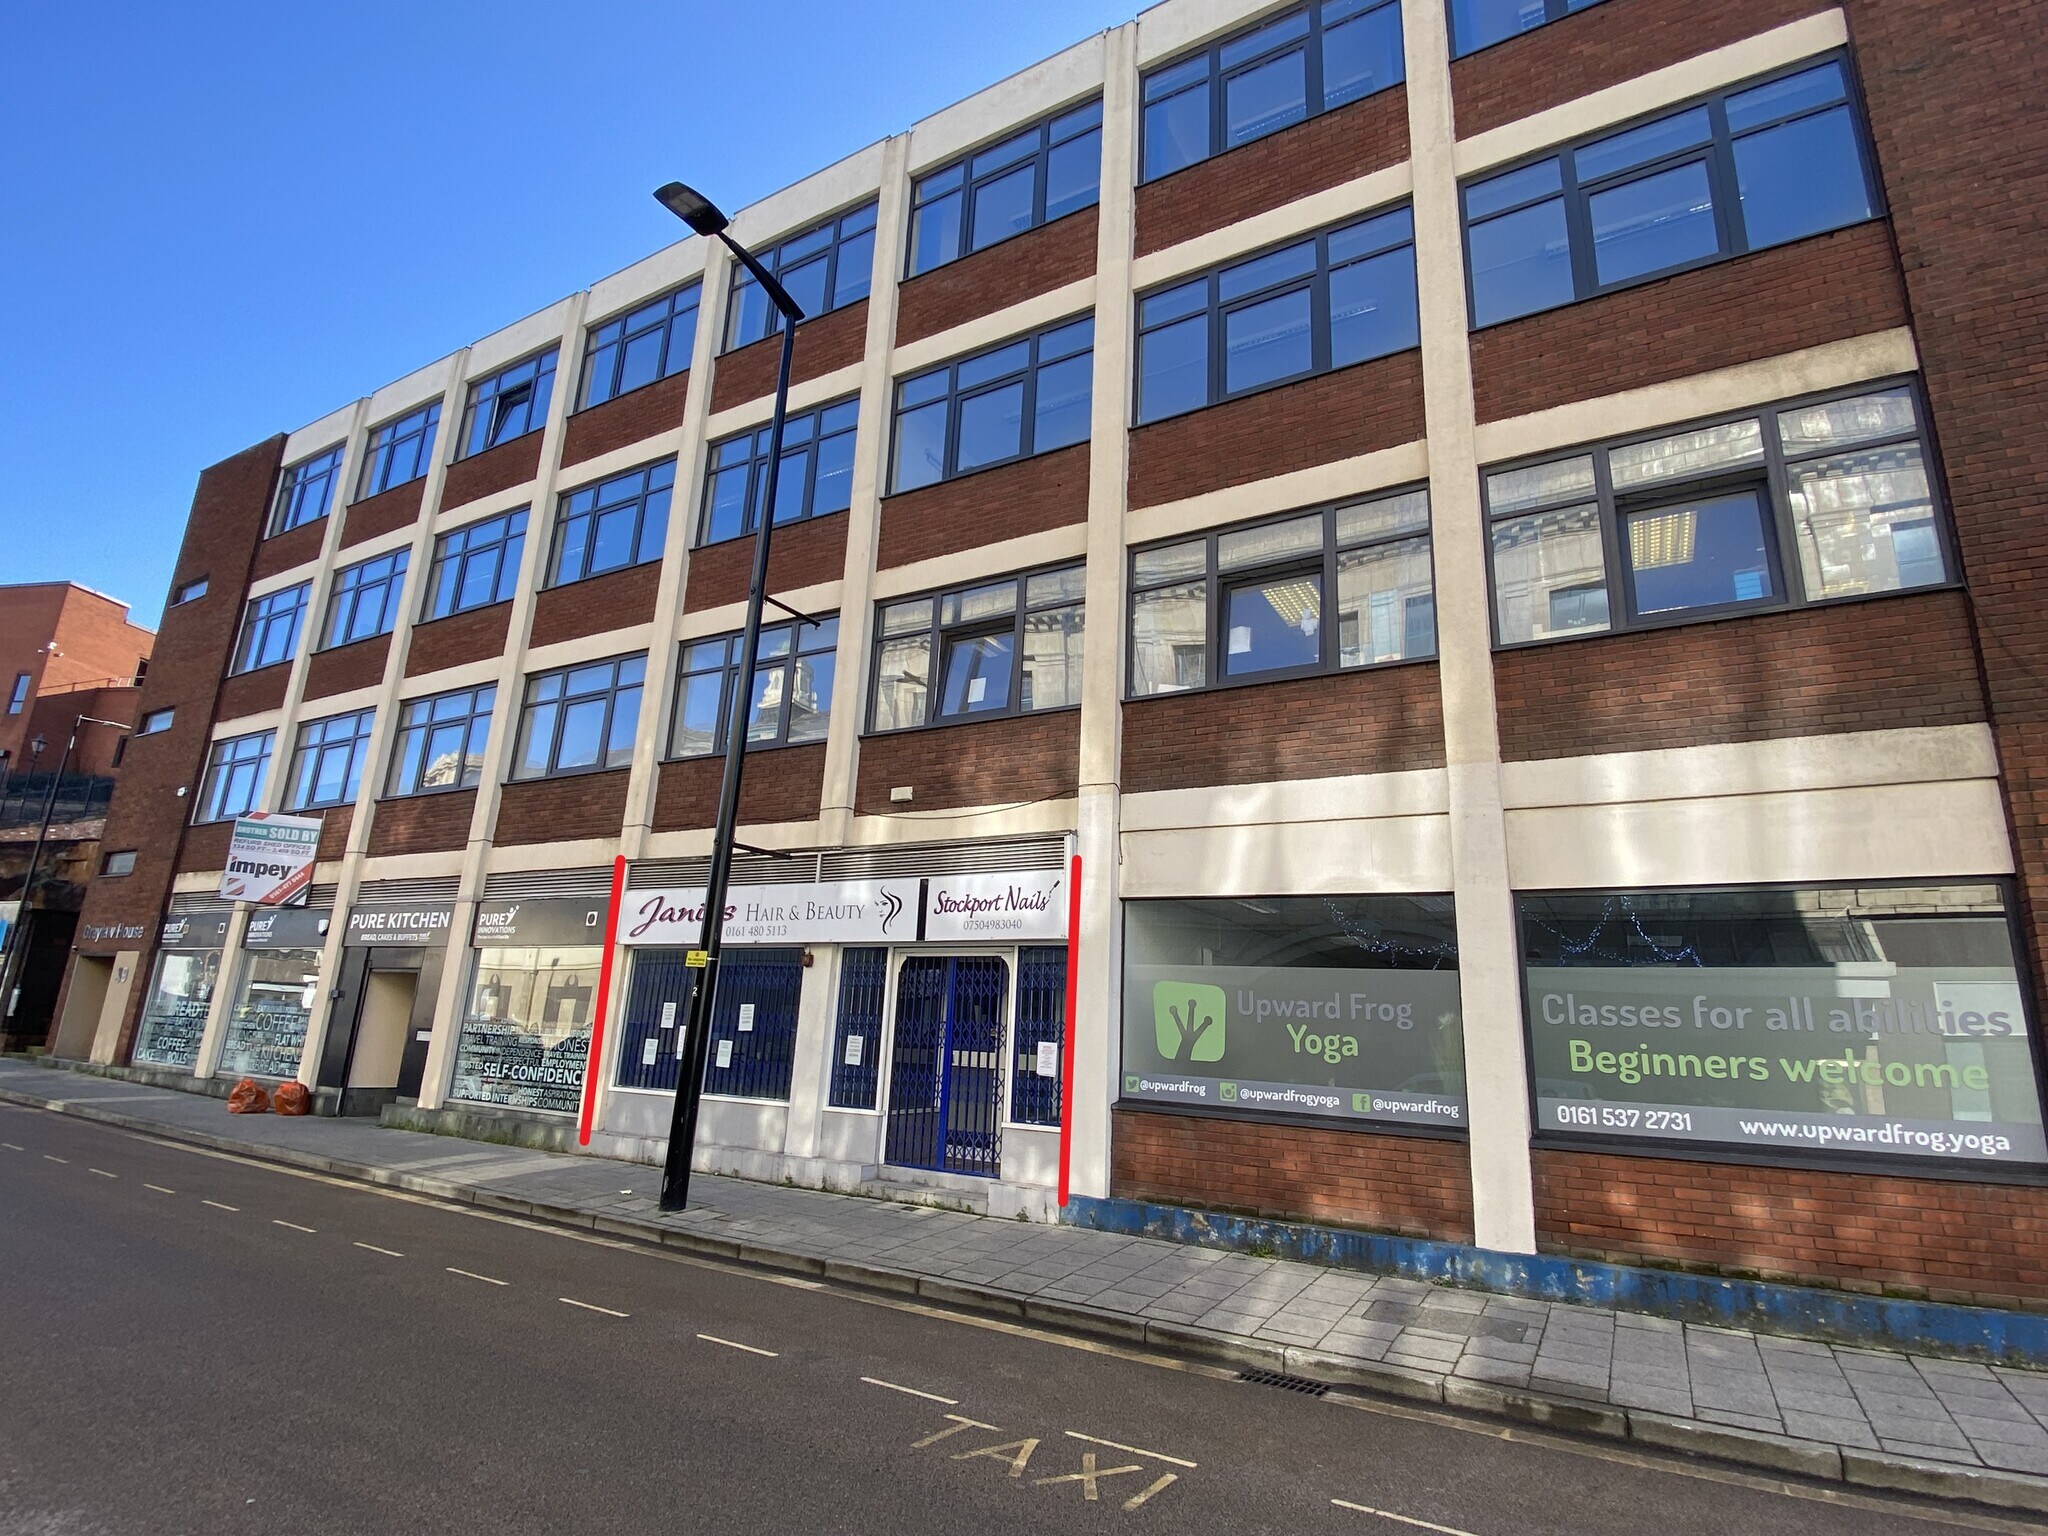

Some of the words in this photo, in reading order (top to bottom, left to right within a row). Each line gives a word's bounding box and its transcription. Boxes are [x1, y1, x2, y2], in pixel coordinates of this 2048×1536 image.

[269, 827, 300, 842] SOLD
[301, 830, 319, 843] BY
[234, 838, 282, 848] REFURBSHED
[283, 843, 311, 851] OFFICES
[229, 856, 292, 880] impey
[934, 890, 1004, 918] Stockport
[1004, 885, 1050, 911] Nails
[350, 913, 386, 929] PURE
[387, 911, 451, 929] KITCHEN
[479, 913, 506, 926] PURE
[629, 895, 737, 938] Janis
[746, 903, 784, 922] HAIR
[789, 904, 801, 921] &
[806, 901, 867, 921] BEAUTY
[963, 919, 1022, 930] 07504983040
[116, 923, 144, 939] House
[163, 923, 181, 933] PURE
[249, 921, 269, 932] PURE
[477, 926, 516, 934] INNOVATIONS
[725, 926, 745, 937] 0161
[748, 926, 765, 937] 480
[766, 925, 787, 937] 5113
[1237, 990, 1341, 1023] Upward
[1350, 993, 1414, 1031] Frog
[1541, 993, 1682, 1028] Classes
[1693, 994, 1752, 1030] for
[1765, 997, 1815, 1033] all
[1829, 1000, 2013, 1038] abilities
[256, 1013, 299, 1032] COFFEE
[463, 1023, 515, 1035] PARTNERSHIP
[157, 1036, 187, 1052] COFFEE
[274, 1034, 290, 1045] FLAT
[461, 1033, 484, 1045] TRAVEL
[485, 1034, 518, 1047] TRAINING
[1286, 1024, 1359, 1064] Yoga
[136, 1047, 156, 1061] CAKE
[226, 1040, 246, 1051] BREAD
[260, 1045, 301, 1063] KITCHEN
[459, 1044, 496, 1055] COMMUNITY
[543, 1050, 562, 1059] TRAVEL
[563, 1051, 587, 1060] TRAININ
[167, 1051, 188, 1065] ROLLS
[458, 1060, 483, 1070] TRUSTED
[541, 1059, 586, 1070] EMPLOYMEN
[1569, 1040, 1769, 1085] Beginners
[1779, 1048, 1990, 1091] welcome
[254, 1060, 281, 1074] BREAD
[483, 1062, 583, 1086] SELF-CONFIDENC
[518, 1086, 544, 1098] HONEST
[1140, 1079, 1206, 1096] @upwardfrog
[453, 1088, 491, 1101] SUPPORTED
[491, 1093, 538, 1108] INTERNSHIPS
[538, 1097, 580, 1111] COMMUNIT
[1240, 1087, 1340, 1108] @upwardfrogyoga
[1373, 1098, 1459, 1119] @upwardfrog
[1557, 1105, 1599, 1126] 0161
[1602, 1107, 1640, 1129] 537
[1645, 1110, 1692, 1132] 2731
[1739, 1118, 2011, 1156] www.upwardfrog.yoga
[910, 1413, 1178, 1512] TAXI
